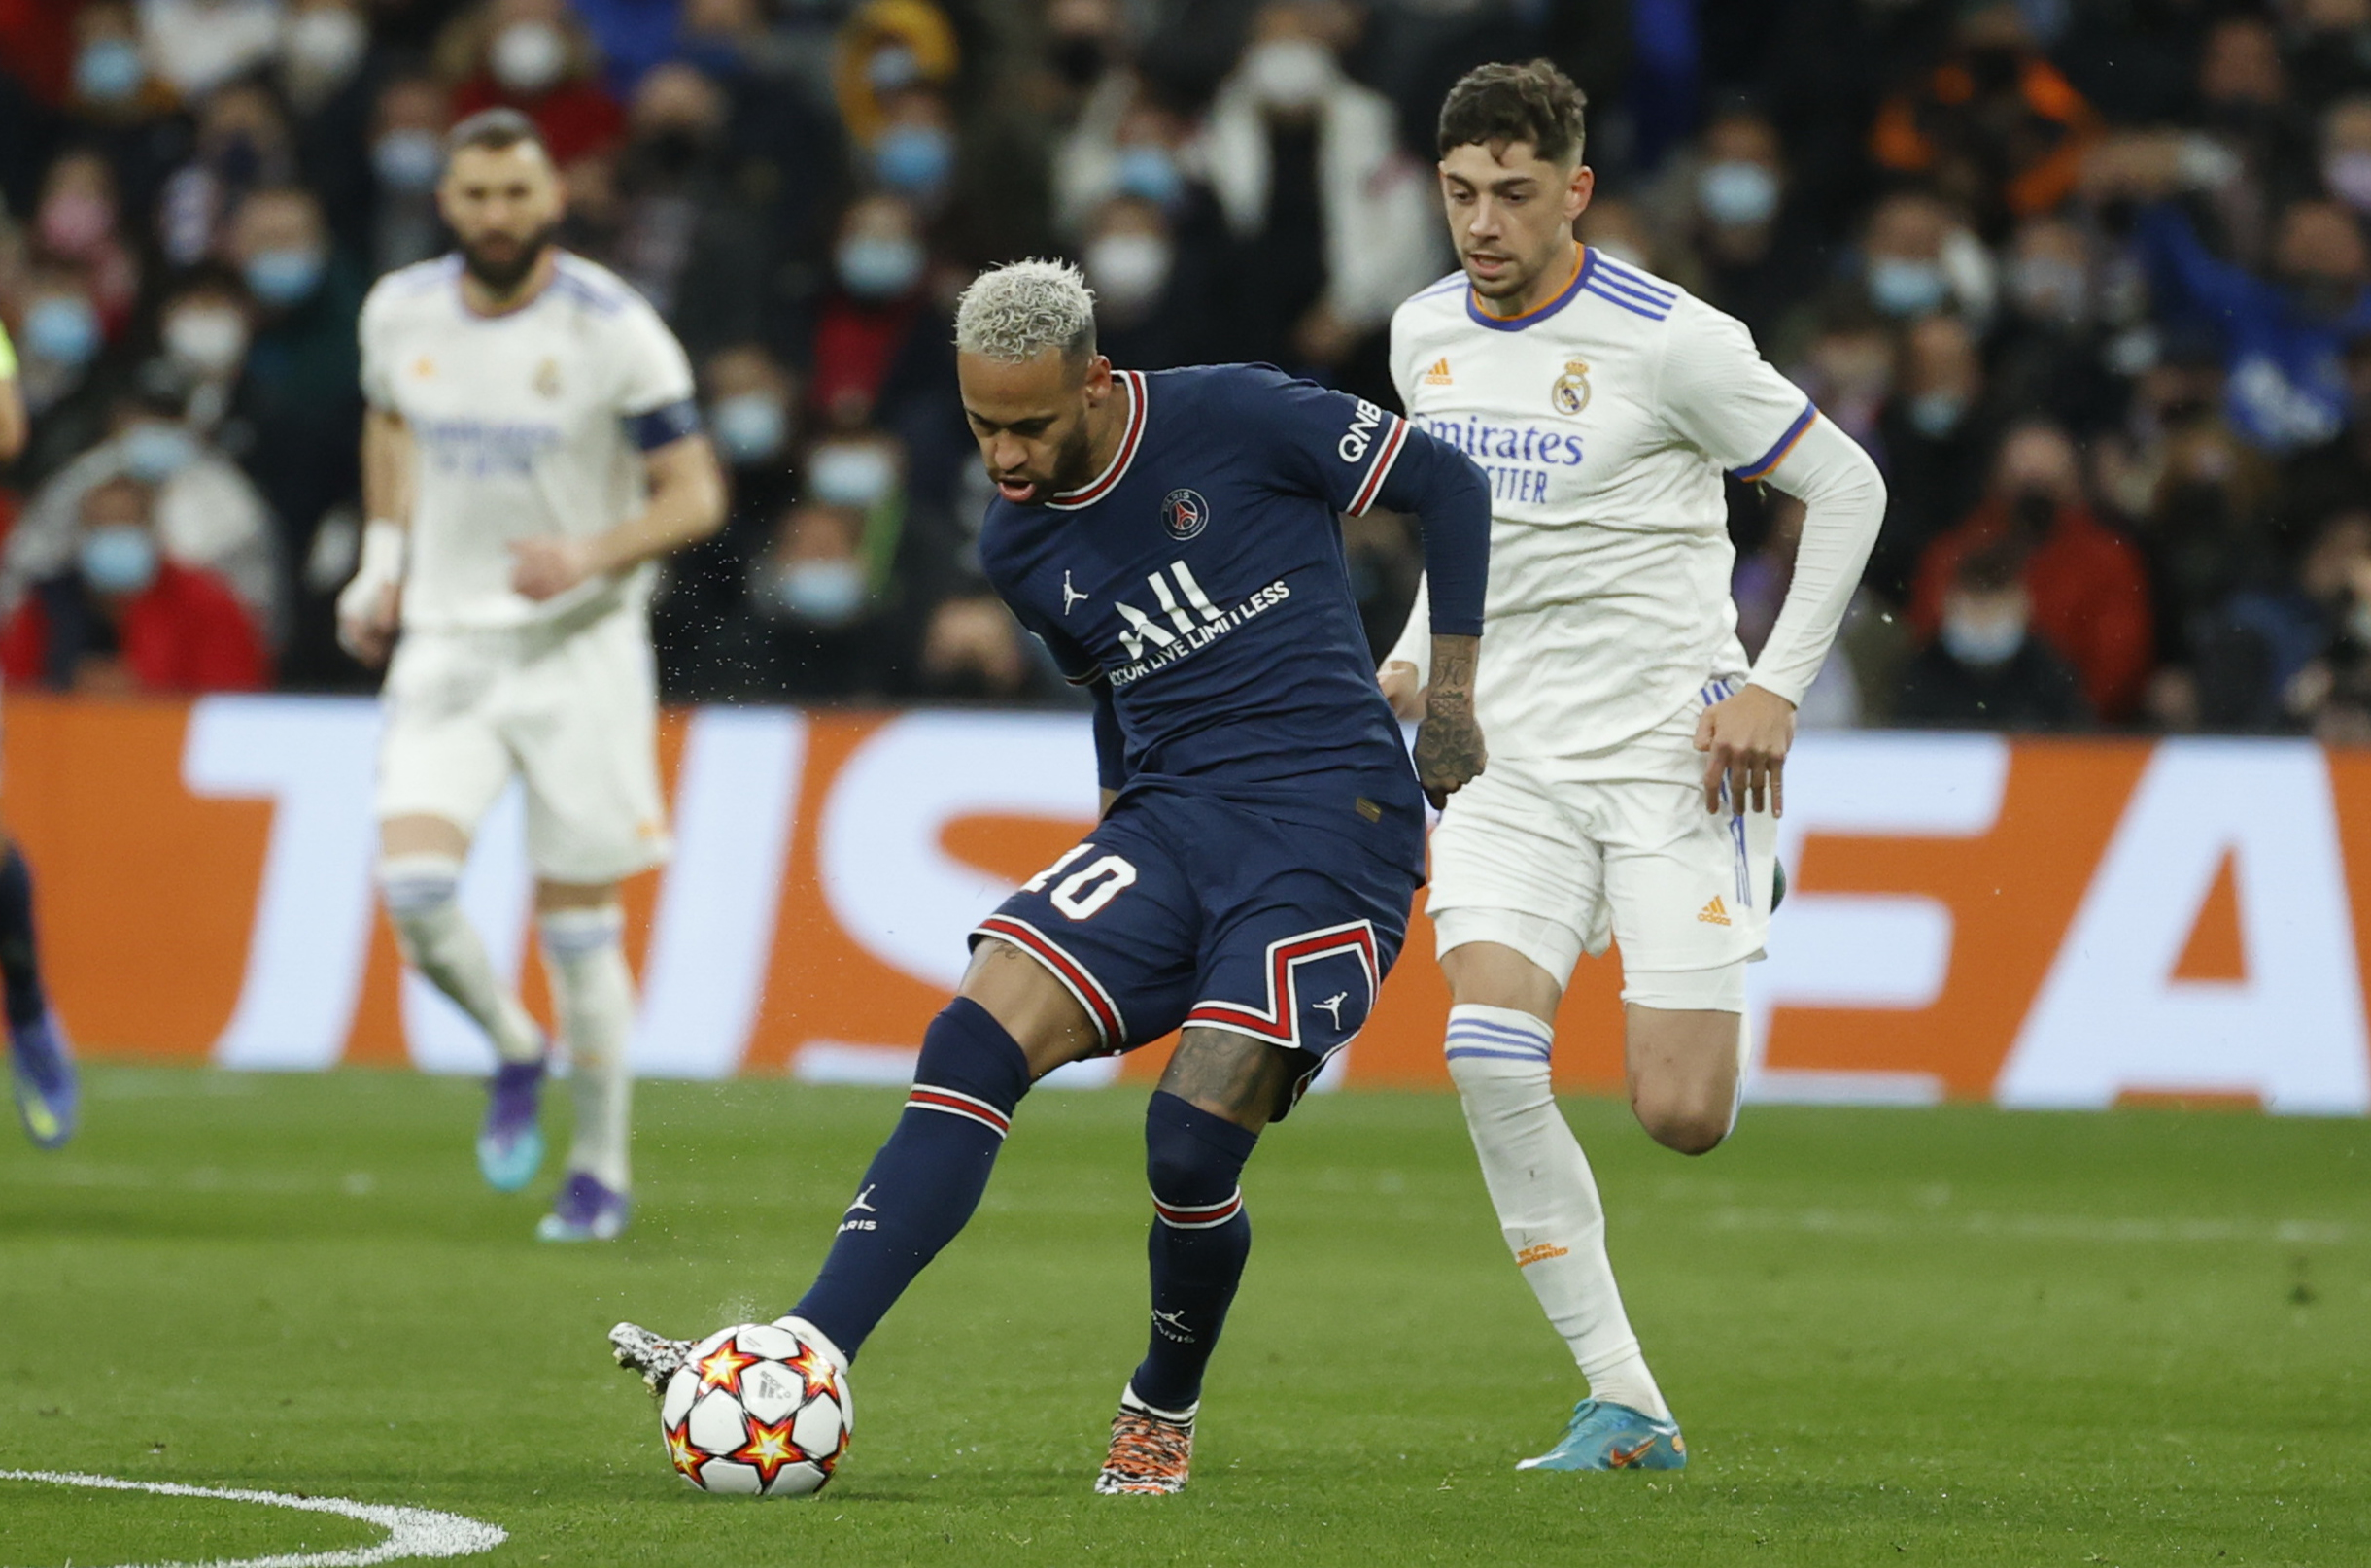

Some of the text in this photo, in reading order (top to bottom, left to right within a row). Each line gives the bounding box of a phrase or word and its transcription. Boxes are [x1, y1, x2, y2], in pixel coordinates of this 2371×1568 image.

[1339, 398, 1382, 462] QNB
[1415, 412, 1584, 466] mirates
[1149, 638, 1189, 670] LIVE
[1018, 843, 1137, 921] 10
